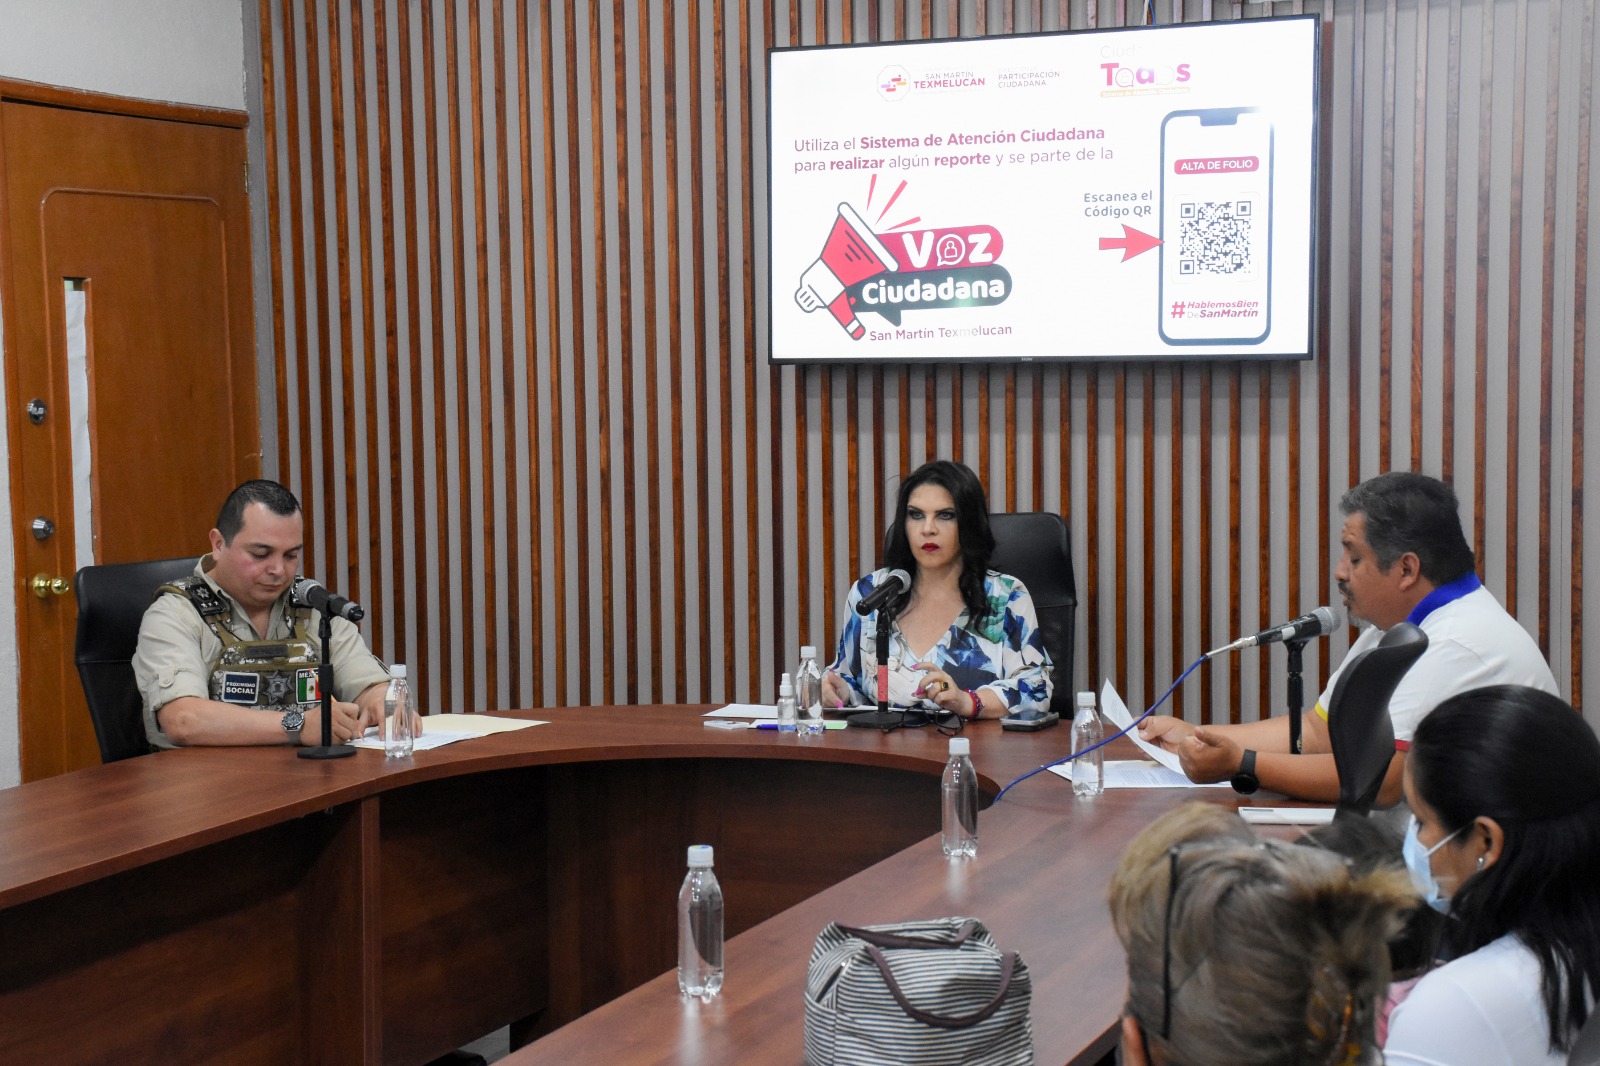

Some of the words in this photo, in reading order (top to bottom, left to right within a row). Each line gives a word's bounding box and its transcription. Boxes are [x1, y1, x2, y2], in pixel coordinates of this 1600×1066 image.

[913, 78, 985, 89] TEXMELUCAN
[998, 80, 1047, 88] CIUDADANA
[794, 138, 839, 152] Utiliza
[843, 137, 856, 150] el
[860, 136, 919, 149] Sistema
[923, 133, 943, 147] de
[947, 130, 1016, 146] Atención
[1020, 127, 1105, 142] Ciudadana
[794, 160, 826, 174] para
[830, 156, 885, 170] realizar
[888, 154, 929, 170] algún
[934, 152, 991, 168] reporte
[995, 153, 1004, 166] y
[1009, 152, 1025, 163] se
[1030, 149, 1071, 165] parte
[1076, 148, 1096, 161] de
[1100, 146, 1113, 160] la
[1180, 161, 1206, 171] ALTA
[1207, 160, 1221, 170] DE
[1222, 159, 1253, 169] FOLIO
[1084, 192, 1137, 203] Escanea
[1141, 190, 1153, 201] el
[1084, 205, 1130, 219] Código
[1133, 205, 1152, 215] QR
[862, 277, 1005, 305] Ciudadana
[870, 330, 892, 341] San
[938, 325, 1013, 338] Texmelucan
[226, 687, 255, 695] SOCIAL
